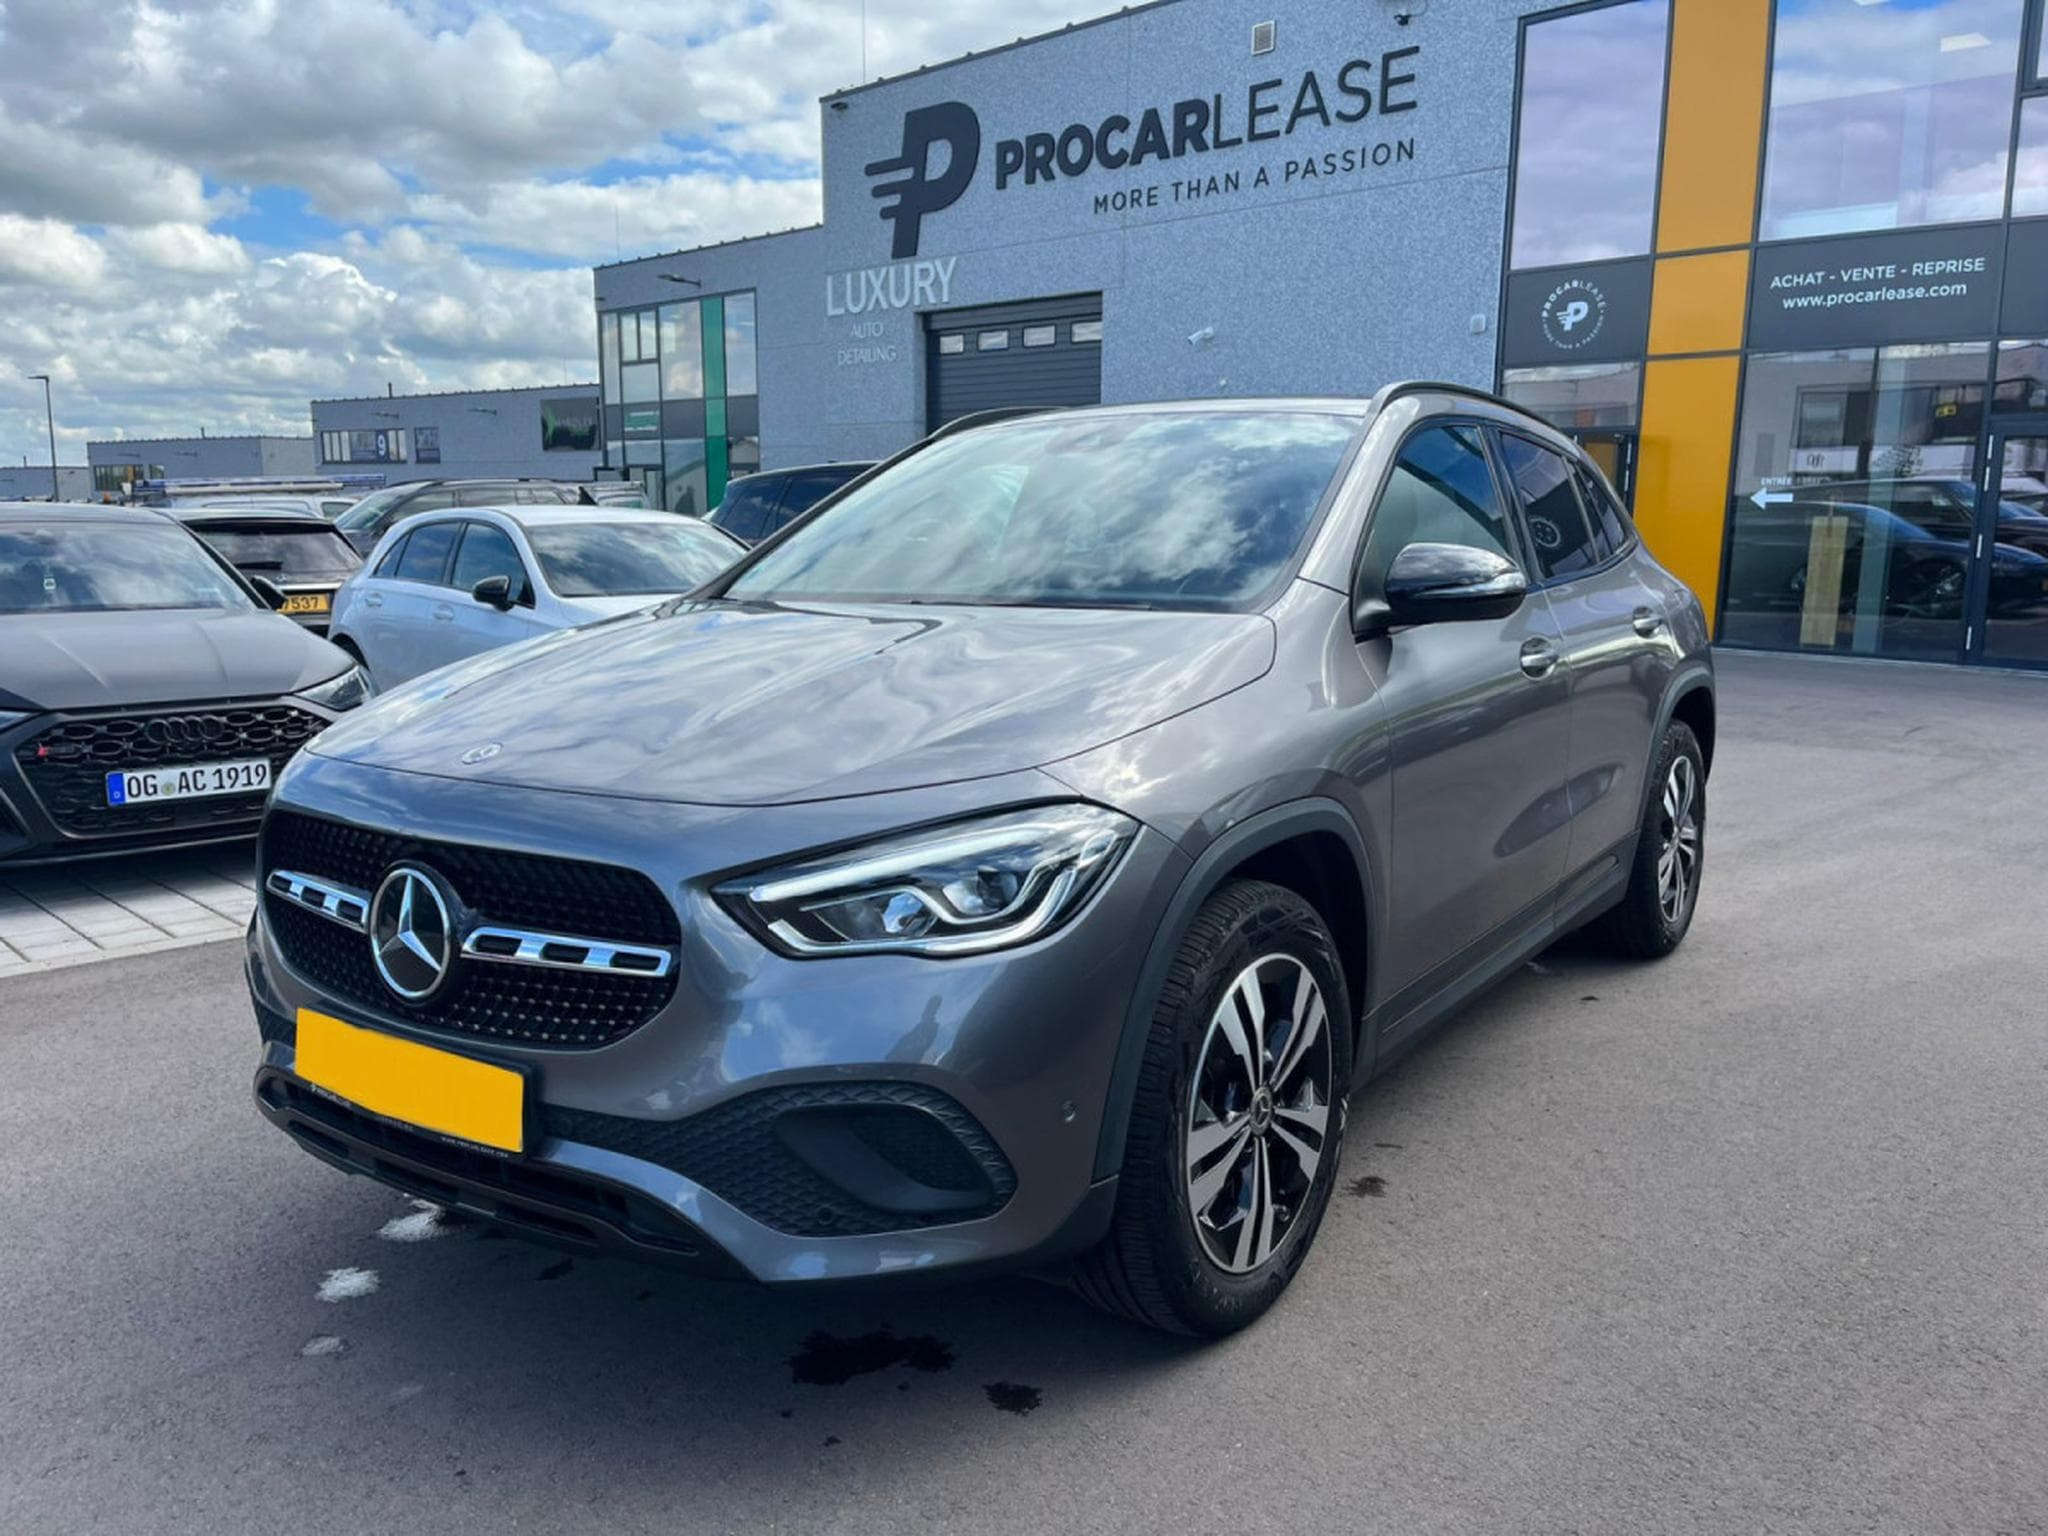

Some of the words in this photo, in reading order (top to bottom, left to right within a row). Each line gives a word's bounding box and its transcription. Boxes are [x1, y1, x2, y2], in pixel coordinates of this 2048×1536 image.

[996, 46, 1420, 190] PROCARLEASE
[1094, 186, 1159, 214] MORE
[1171, 171, 1240, 203] THAN
[1254, 166, 1270, 189] A
[1285, 137, 1414, 183] PASSION
[827, 257, 957, 316] LUXURY
[1770, 272, 1826, 290] ACHAT
[1840, 265, 1897, 283] VENTE
[1912, 257, 1986, 277] REPRISE
[1782, 283, 1968, 310] www.procarlease.com
[850, 321, 884, 339] AUTO
[837, 345, 898, 366] DETAILING
[127, 775, 158, 798] OG
[178, 770, 207, 793] AC
[213, 763, 267, 790] 1919
